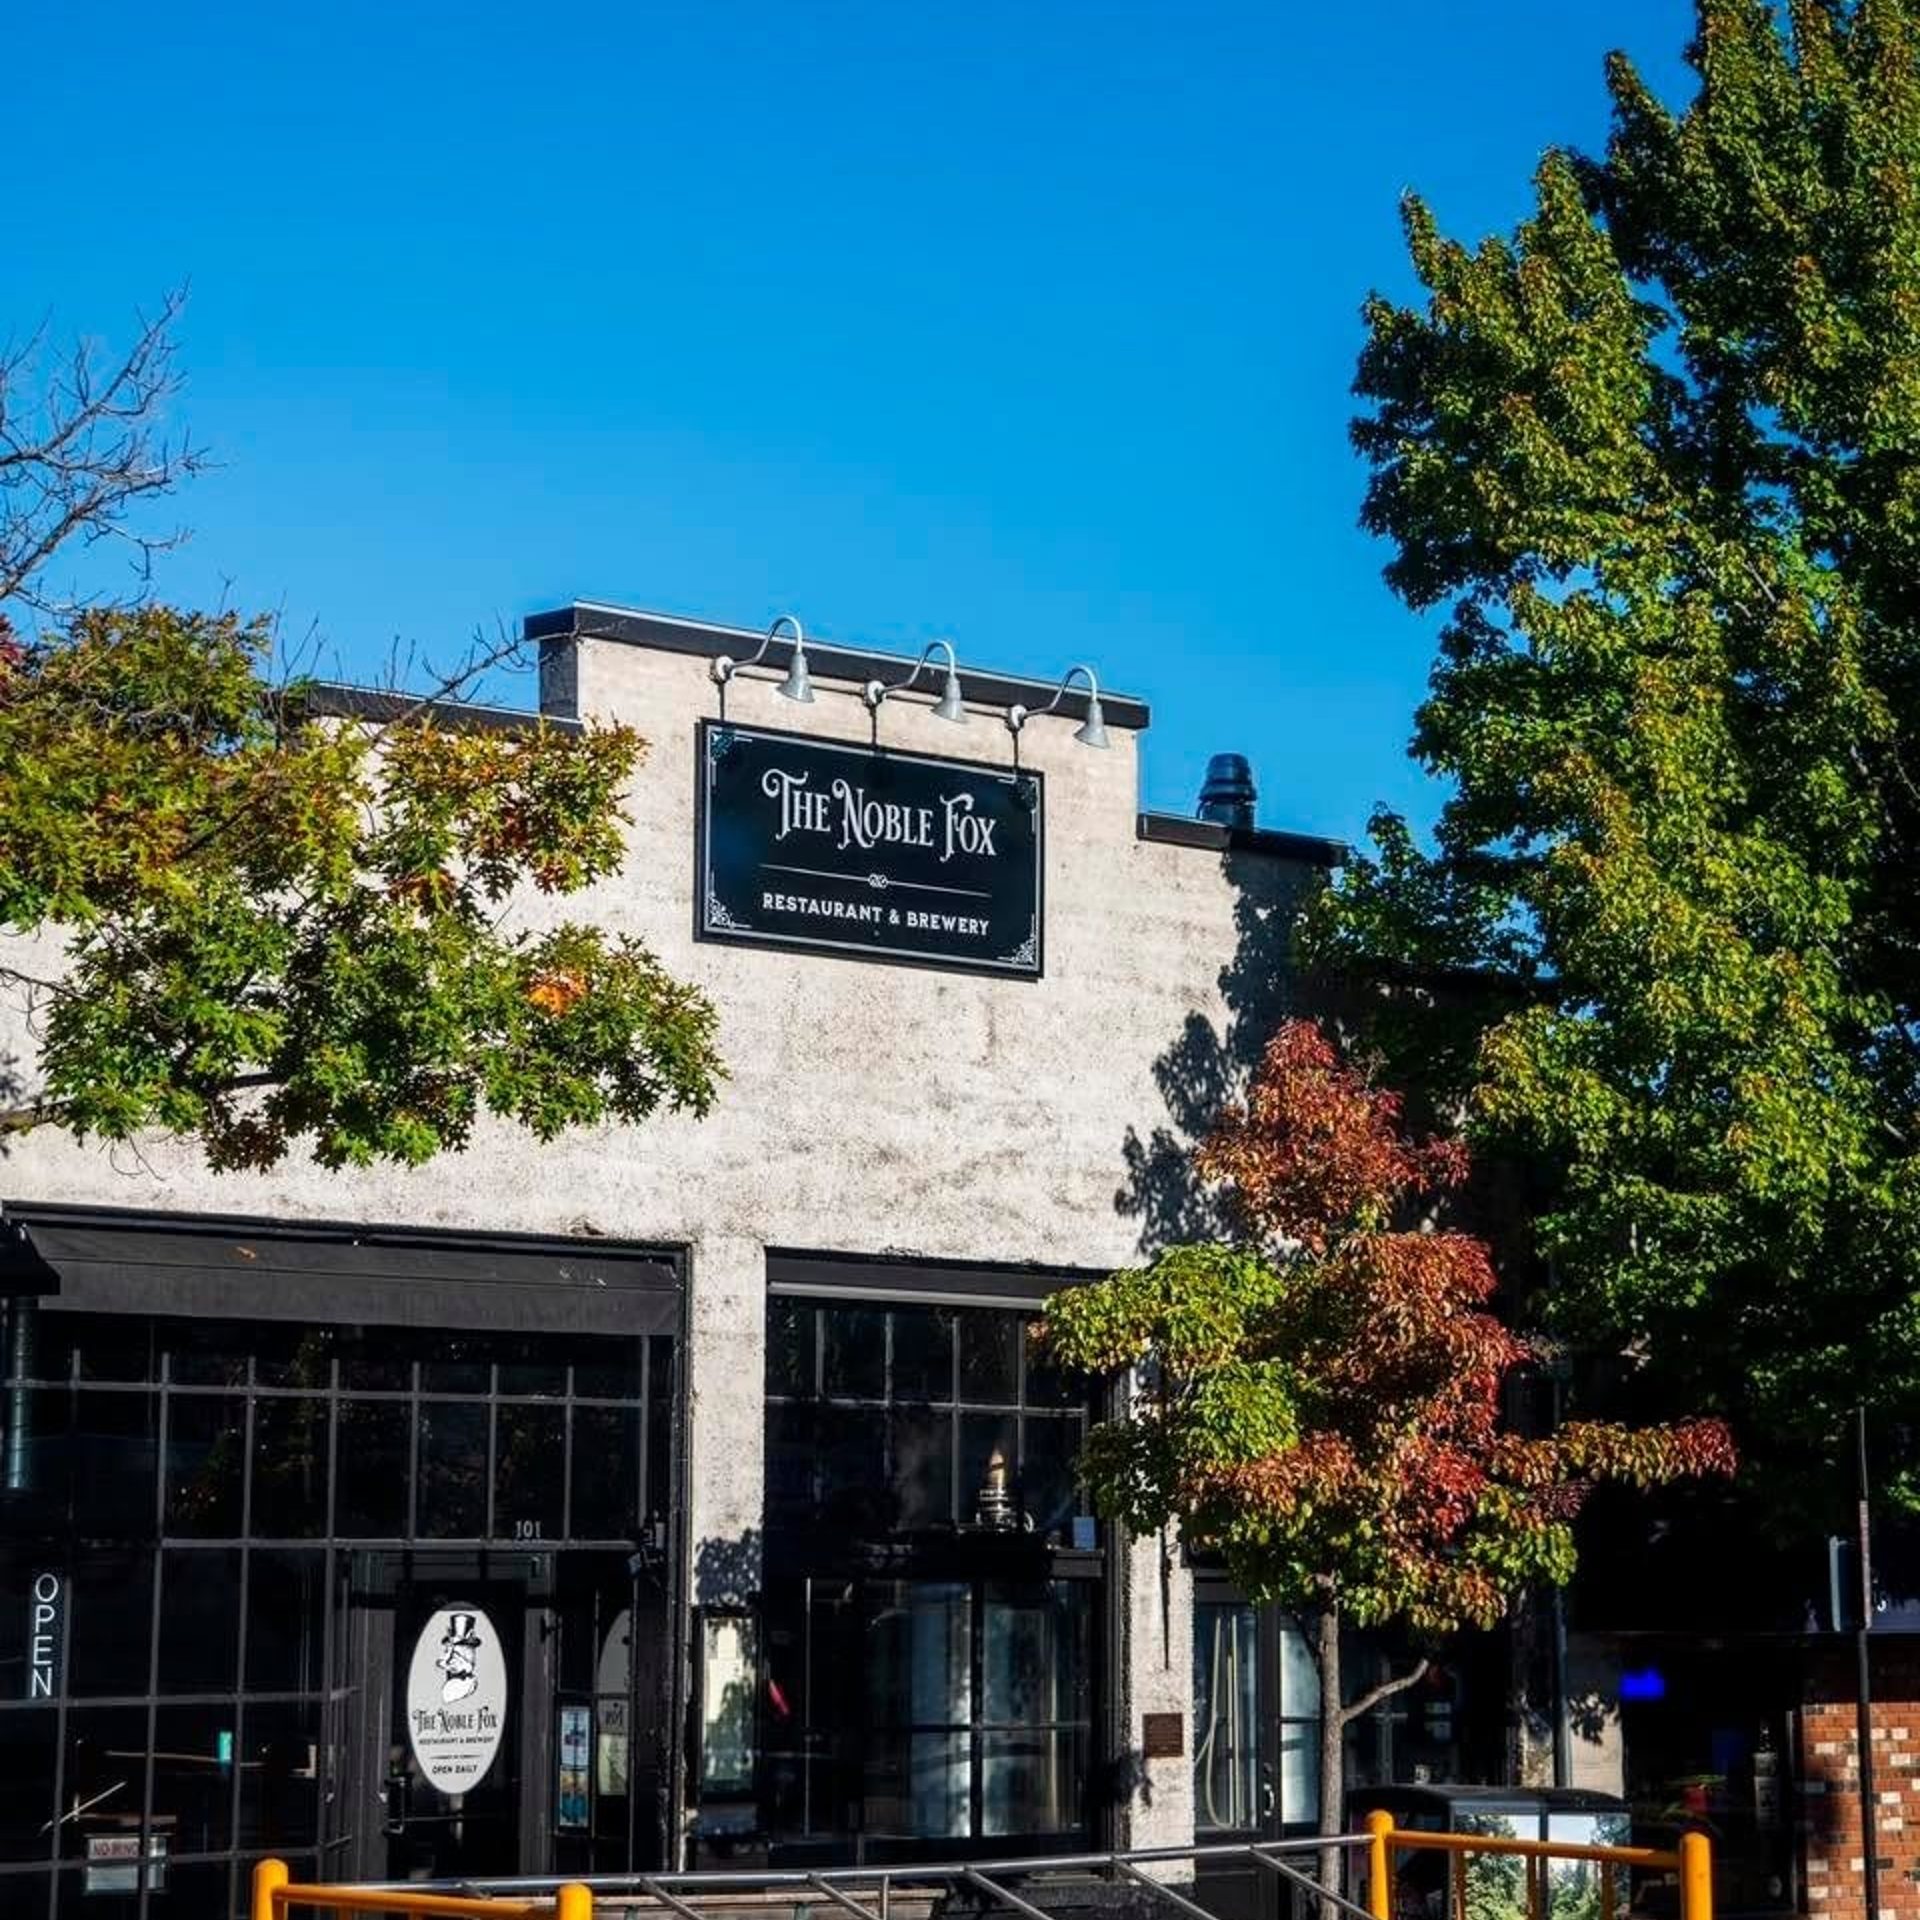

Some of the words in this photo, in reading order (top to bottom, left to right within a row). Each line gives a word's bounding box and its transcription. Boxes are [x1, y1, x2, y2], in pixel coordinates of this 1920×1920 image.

[762, 768, 831, 841] THE
[831, 778, 934, 850] NOBLE
[939, 793, 997, 862] FOX
[762, 892, 883, 923] RESTAURANT
[889, 908, 900, 924] &
[907, 911, 989, 936] BREWERY
[515, 1520, 541, 1538] 101
[31, 1572, 59, 1698] OPEN
[432, 1765, 453, 1774] OPEN
